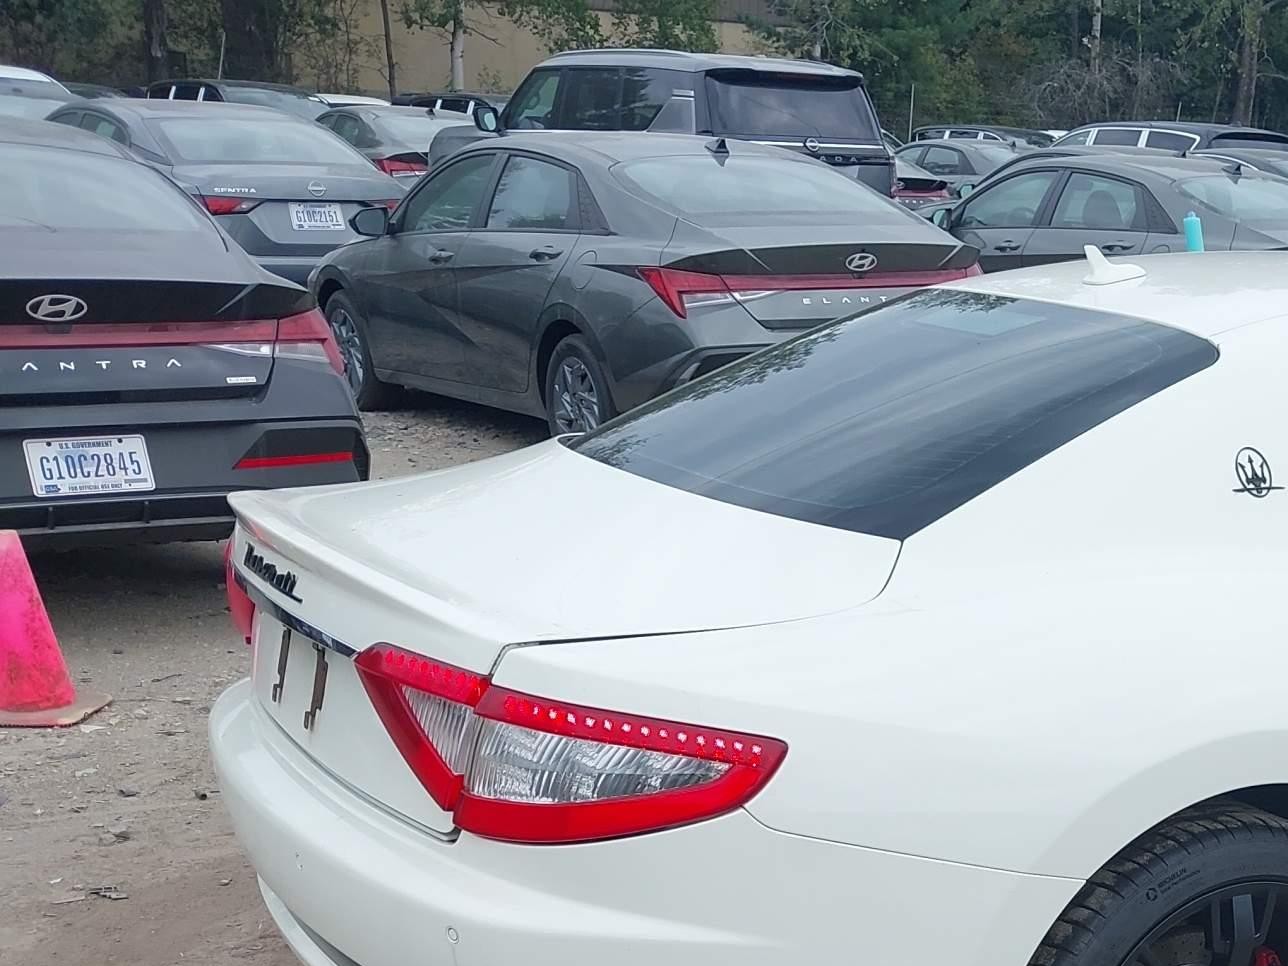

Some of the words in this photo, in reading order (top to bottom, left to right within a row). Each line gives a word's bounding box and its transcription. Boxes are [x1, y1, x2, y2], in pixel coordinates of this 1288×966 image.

[213, 186, 257, 194] SENTRA
[21, 357, 183, 372] ANTRA
[71, 439, 114, 449] GOVERNMENT
[39, 450, 142, 481] G10C2845
